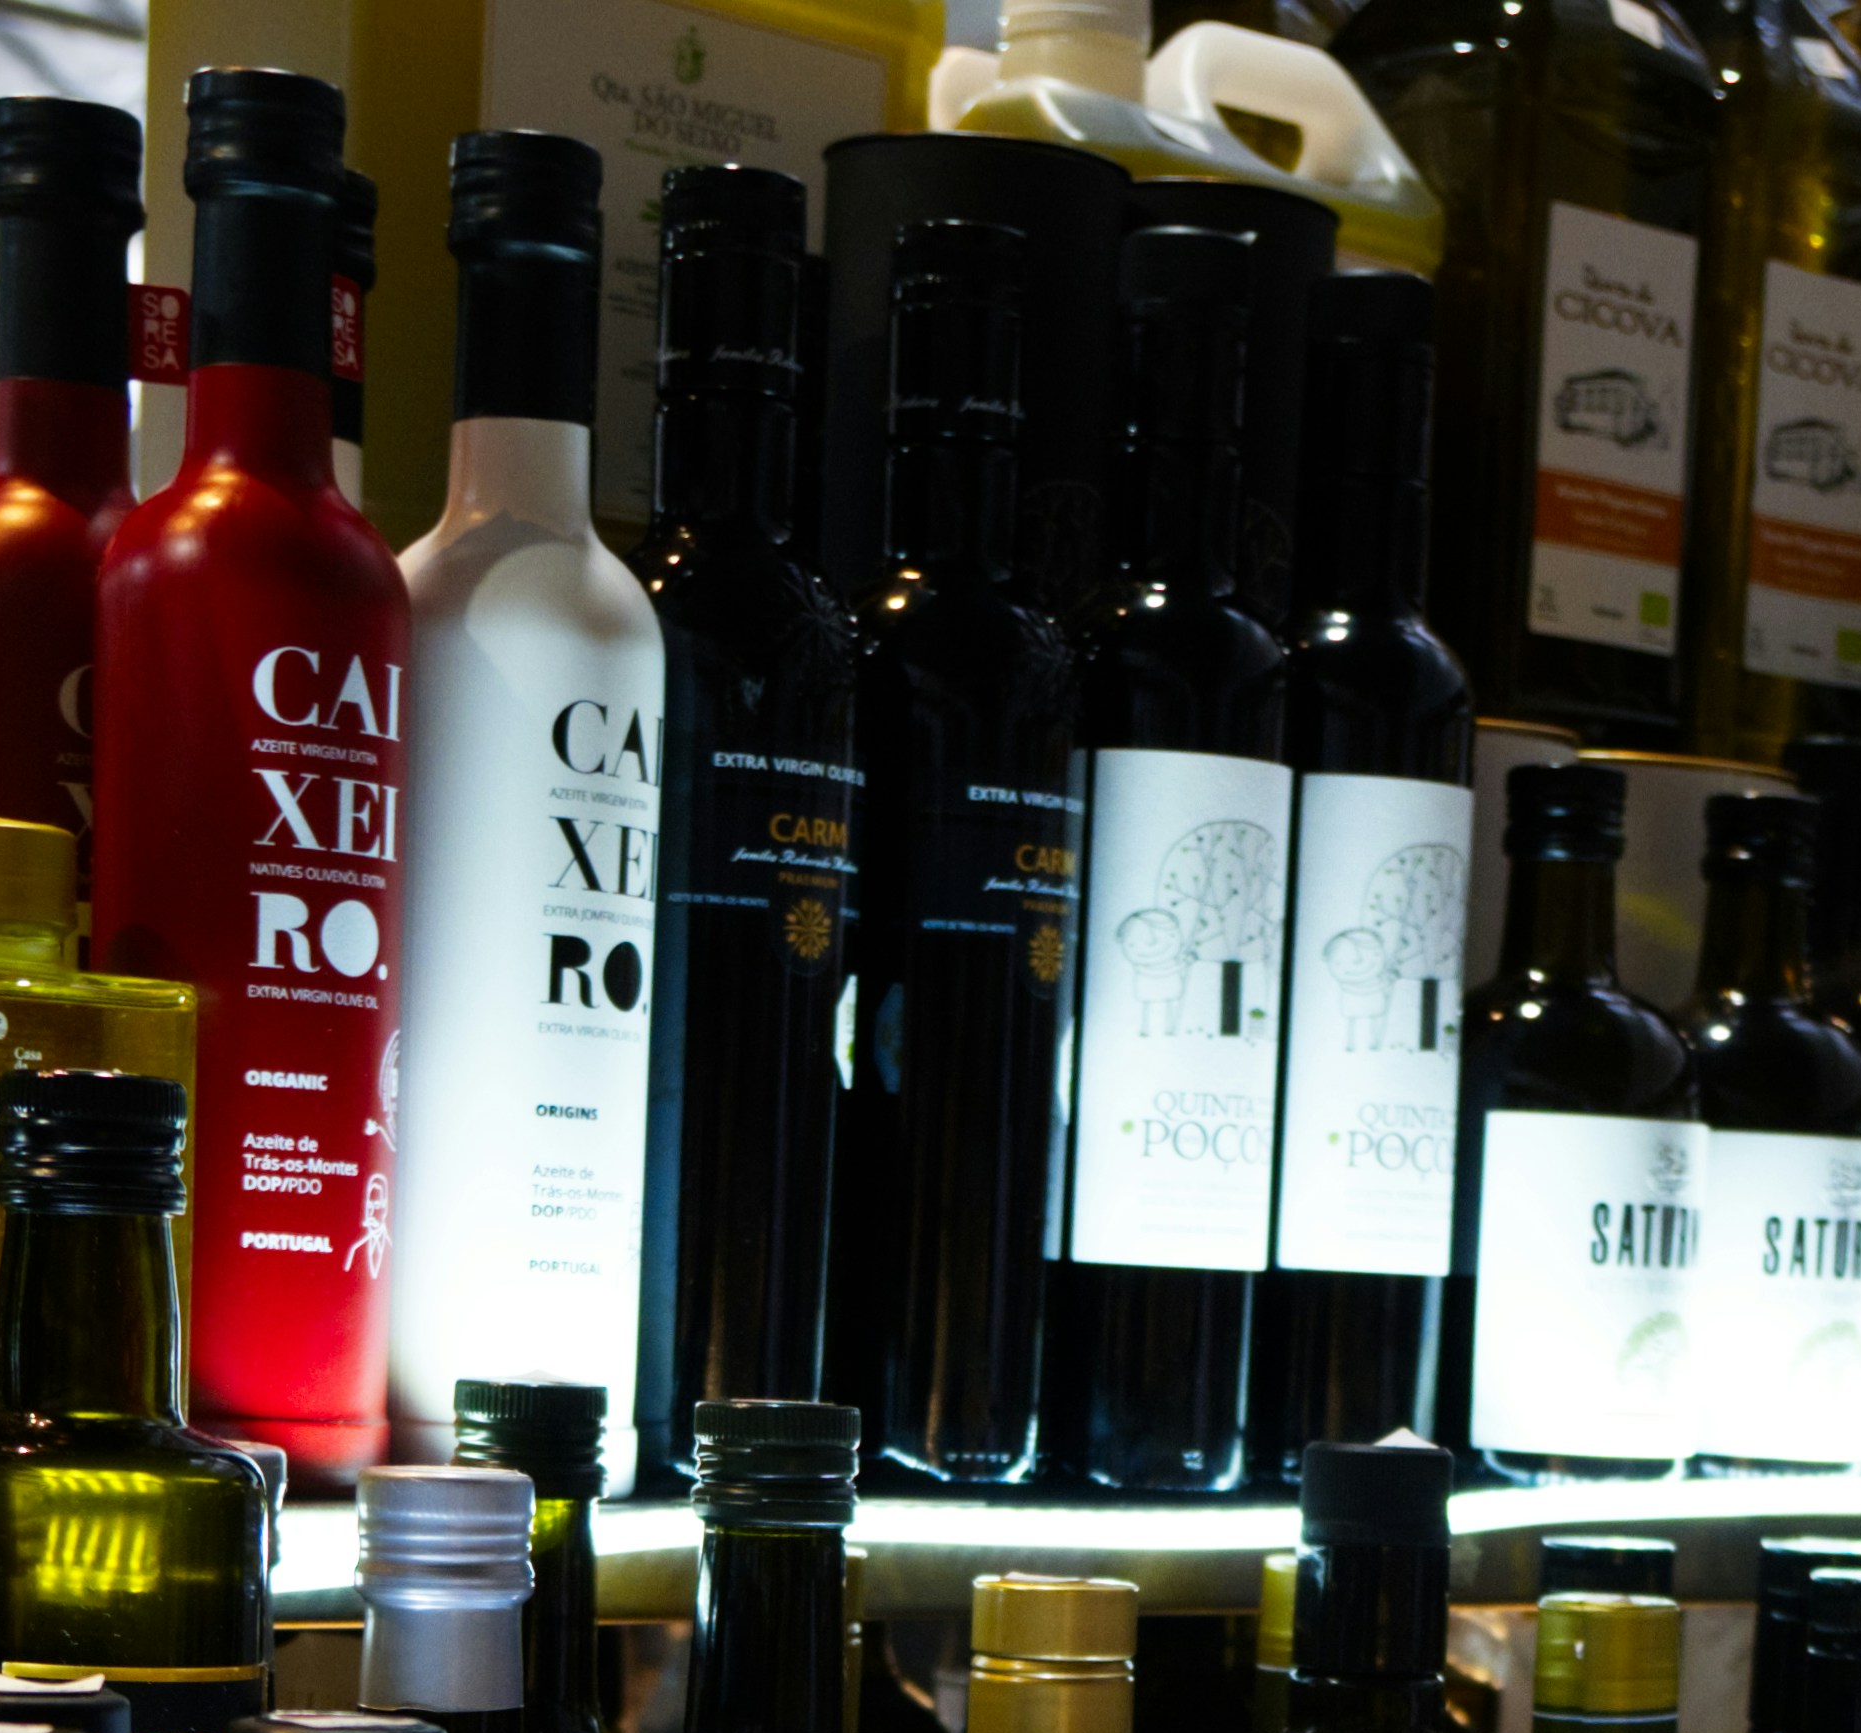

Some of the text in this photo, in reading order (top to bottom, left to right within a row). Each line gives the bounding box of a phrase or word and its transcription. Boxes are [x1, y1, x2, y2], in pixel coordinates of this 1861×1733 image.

[142, 344, 180, 371] SA
[251, 738, 379, 767] AZEITE VIRGEM EXTRA
[712, 751, 826, 779] EXTRA VIRGIN
[549, 786, 589, 802] AZEITE
[967, 784, 1019, 806] EXTRA
[251, 768, 399, 863] XEI
[768, 812, 848, 849] CARM
[249, 862, 303, 880] NATIVES
[305, 865, 360, 886] OLIVENÖL
[543, 904, 579, 919] EXTRA
[247, 983, 289, 1001] EXTRA
[290, 987, 332, 1006] VIRGIN
[334, 991, 363, 1009] OLIVE
[537, 1020, 574, 1037] EXTRA
[12, 1046, 44, 1062] Casa
[244, 1068, 328, 1092] ORGANIC
[535, 1103, 599, 1121] ORIGINS
[243, 1132, 319, 1153] Azeite de
[243, 1153, 359, 1177] Trás-os-Montes
[531, 1163, 594, 1181] Azeite de
[242, 1174, 323, 1196] DOP/PDO
[531, 1203, 597, 1222] DOP/PDO
[241, 1231, 334, 1254] PORTUGAL
[529, 1258, 603, 1276] PORTUGAL
